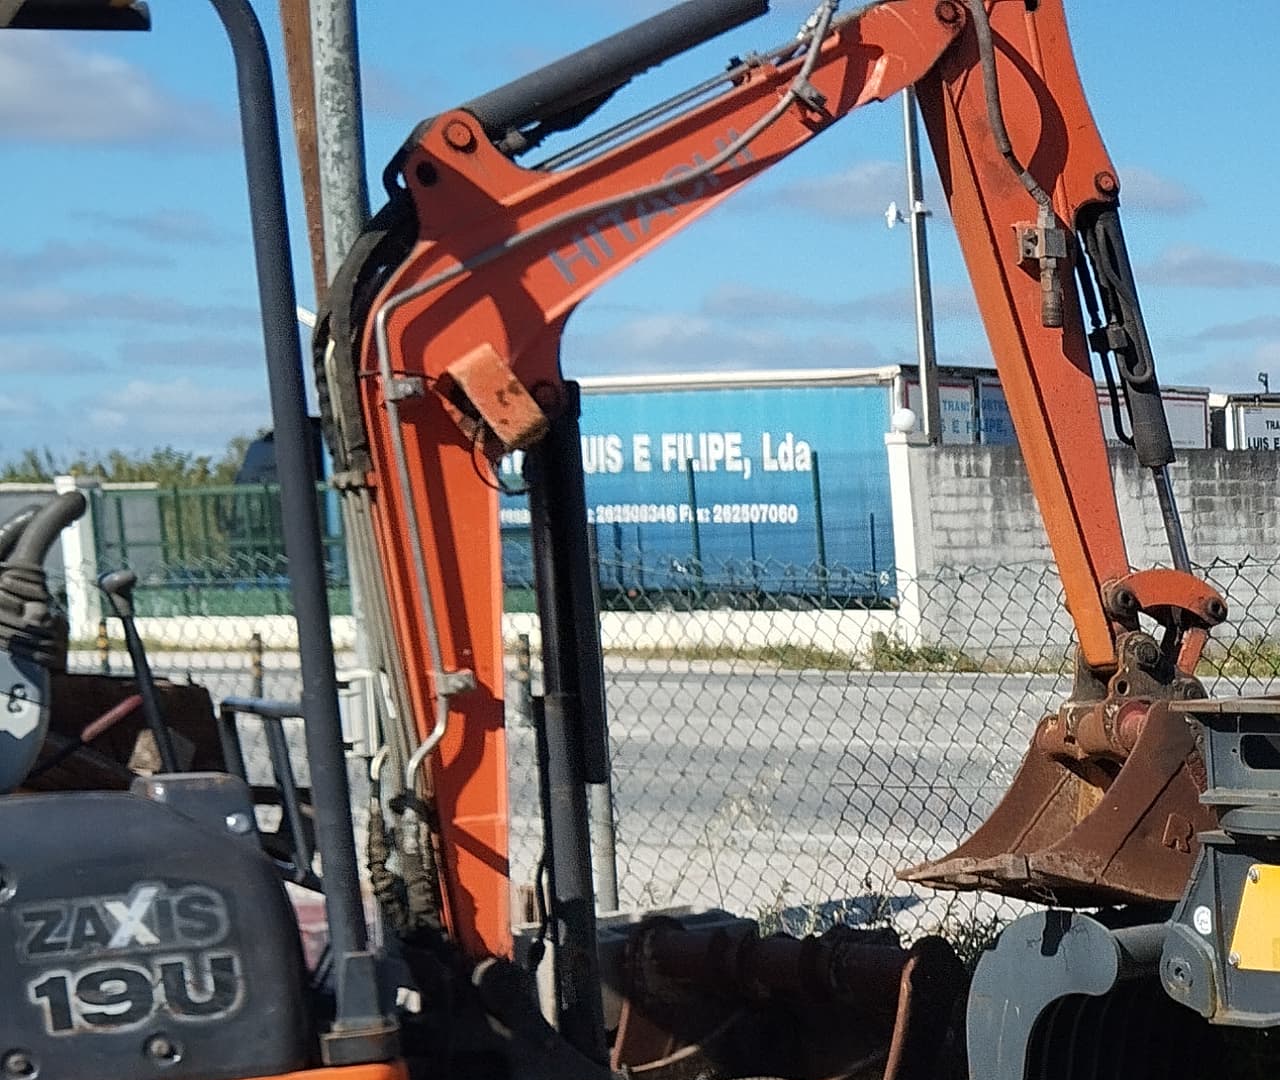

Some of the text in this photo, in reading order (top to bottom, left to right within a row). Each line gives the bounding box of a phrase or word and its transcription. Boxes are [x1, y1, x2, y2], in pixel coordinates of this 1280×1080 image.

[580, 434, 624, 474] UIS
[632, 433, 652, 472] E
[762, 432, 812, 472] Lda
[21, 882, 230, 957] ZAXIS
[28, 953, 244, 1036] 19U
